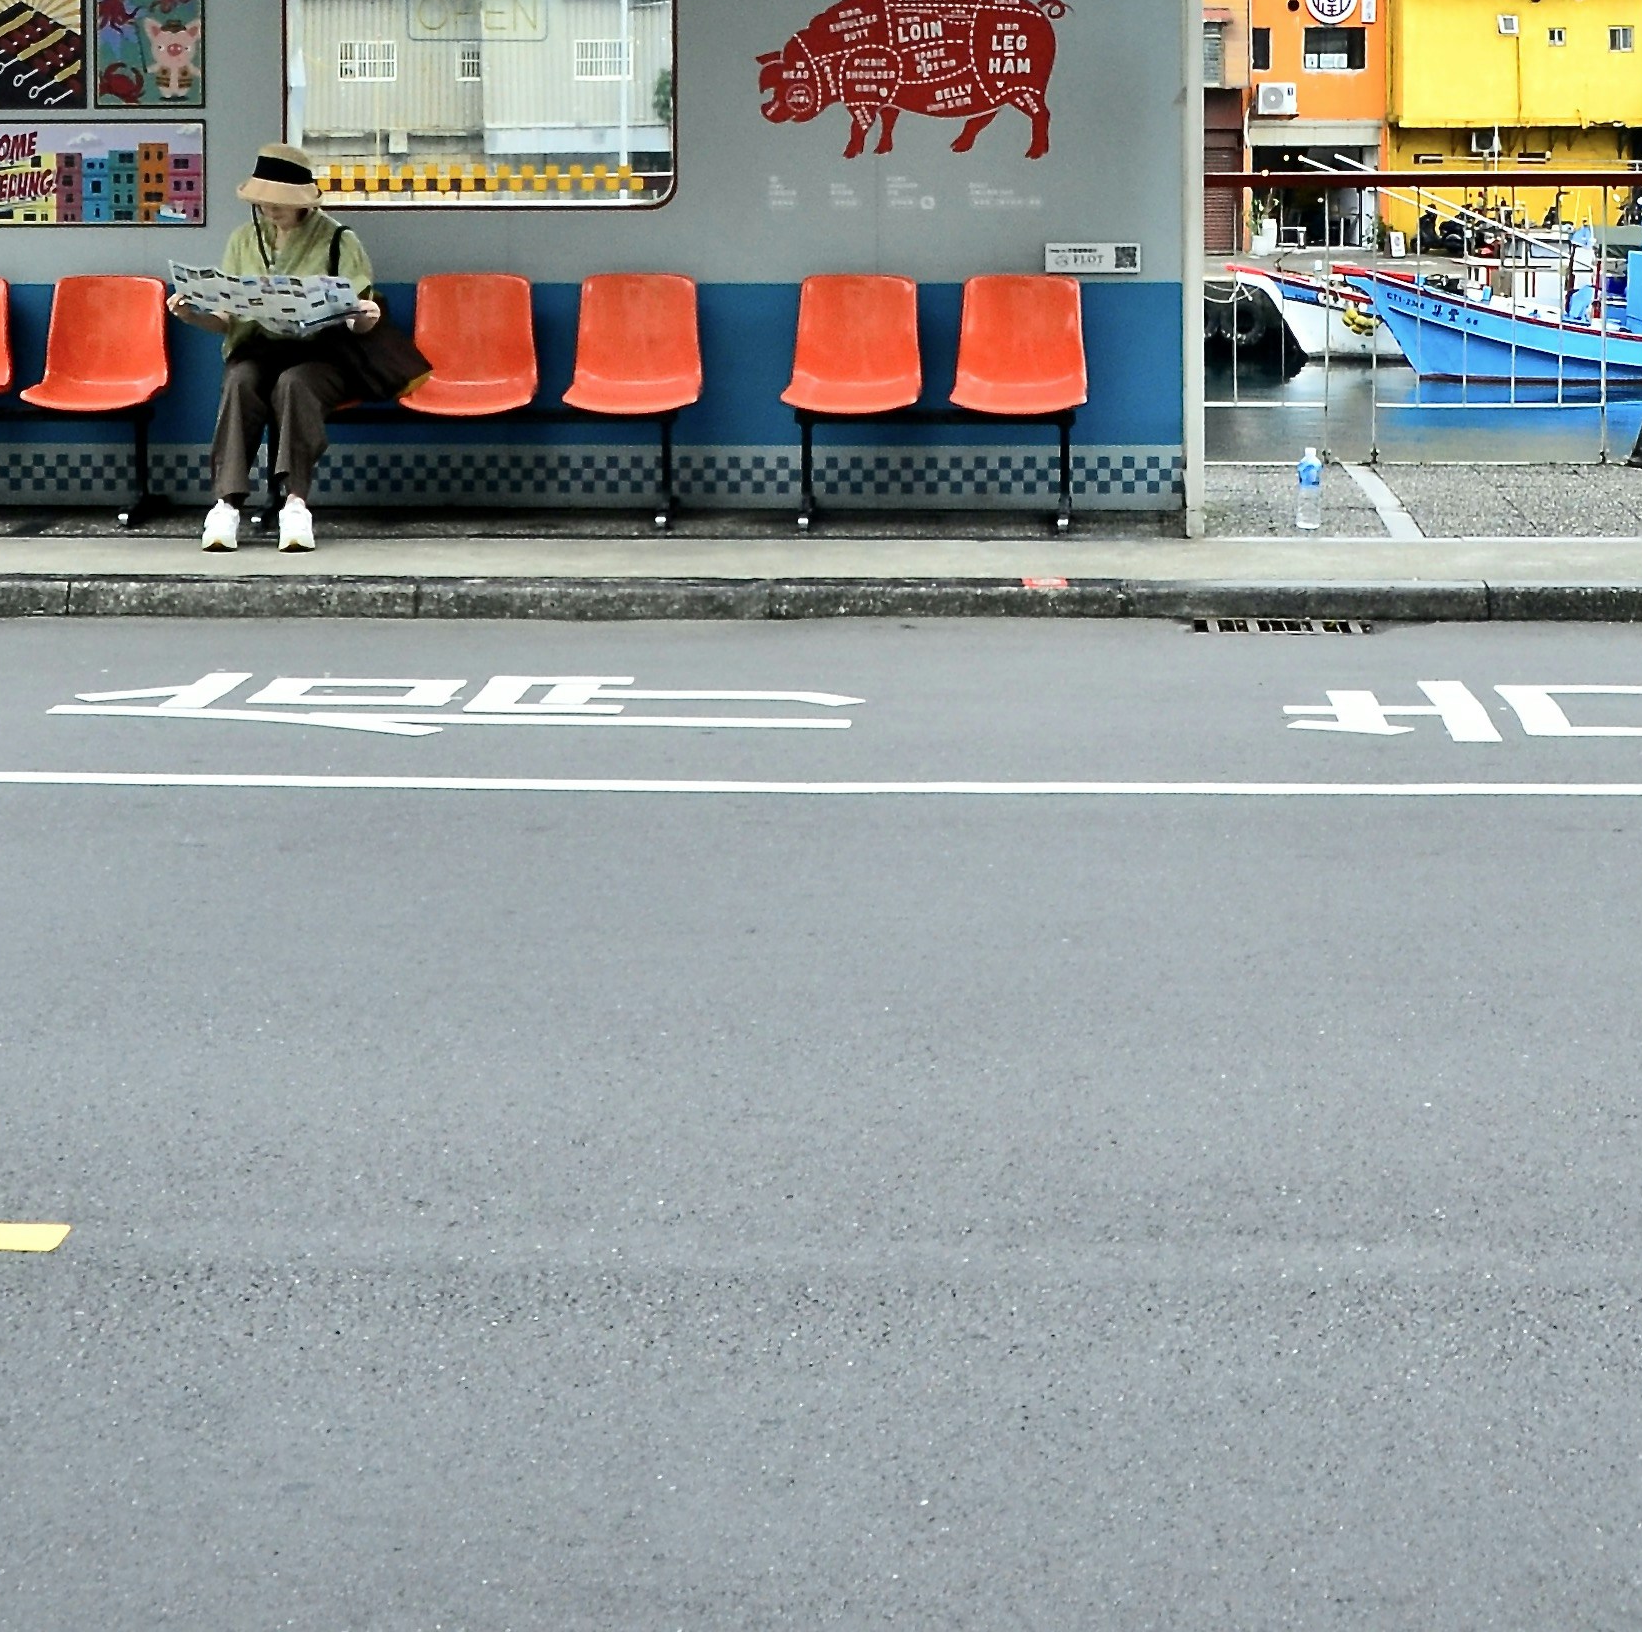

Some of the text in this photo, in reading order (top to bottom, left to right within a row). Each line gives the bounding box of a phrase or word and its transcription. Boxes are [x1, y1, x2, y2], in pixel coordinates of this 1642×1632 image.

[897, 20, 943, 43] LOIN
[991, 35, 1028, 51] LEG
[988, 57, 1031, 74] HAM
